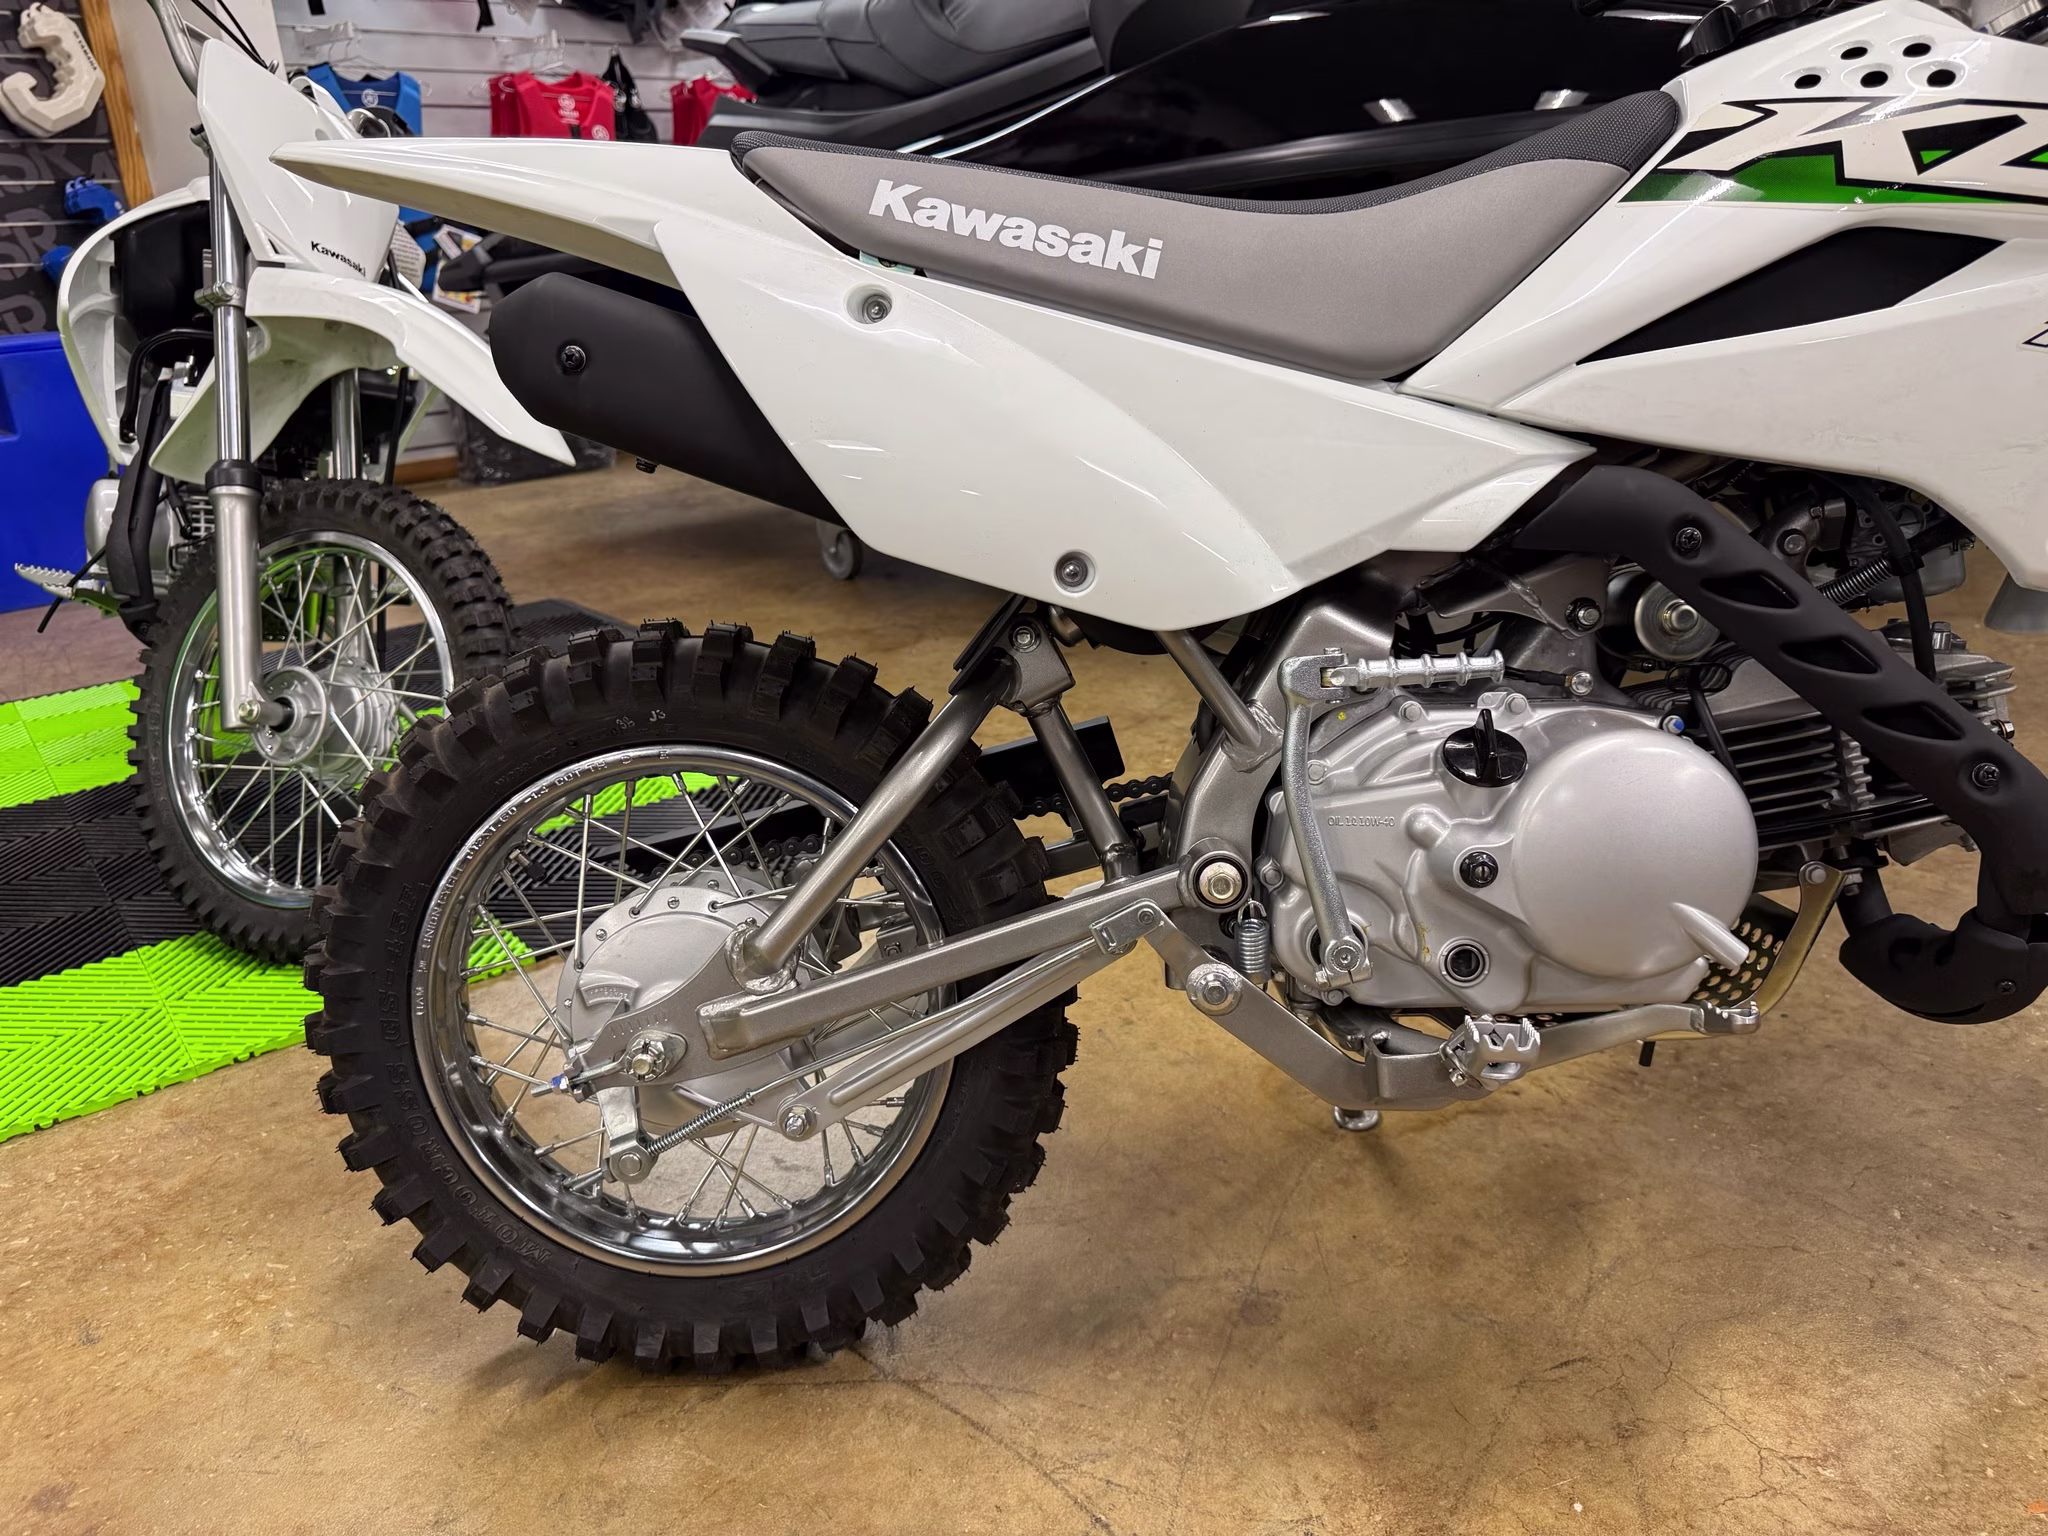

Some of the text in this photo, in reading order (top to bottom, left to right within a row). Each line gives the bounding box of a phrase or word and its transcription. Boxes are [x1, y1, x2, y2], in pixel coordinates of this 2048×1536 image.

[868, 178, 1164, 280] Kawasaki
[310, 240, 366, 277] Kawasaki
[1327, 814, 1345, 827] OIL
[1359, 814, 1396, 827] 10W-40
[421, 906, 443, 950] UNION
